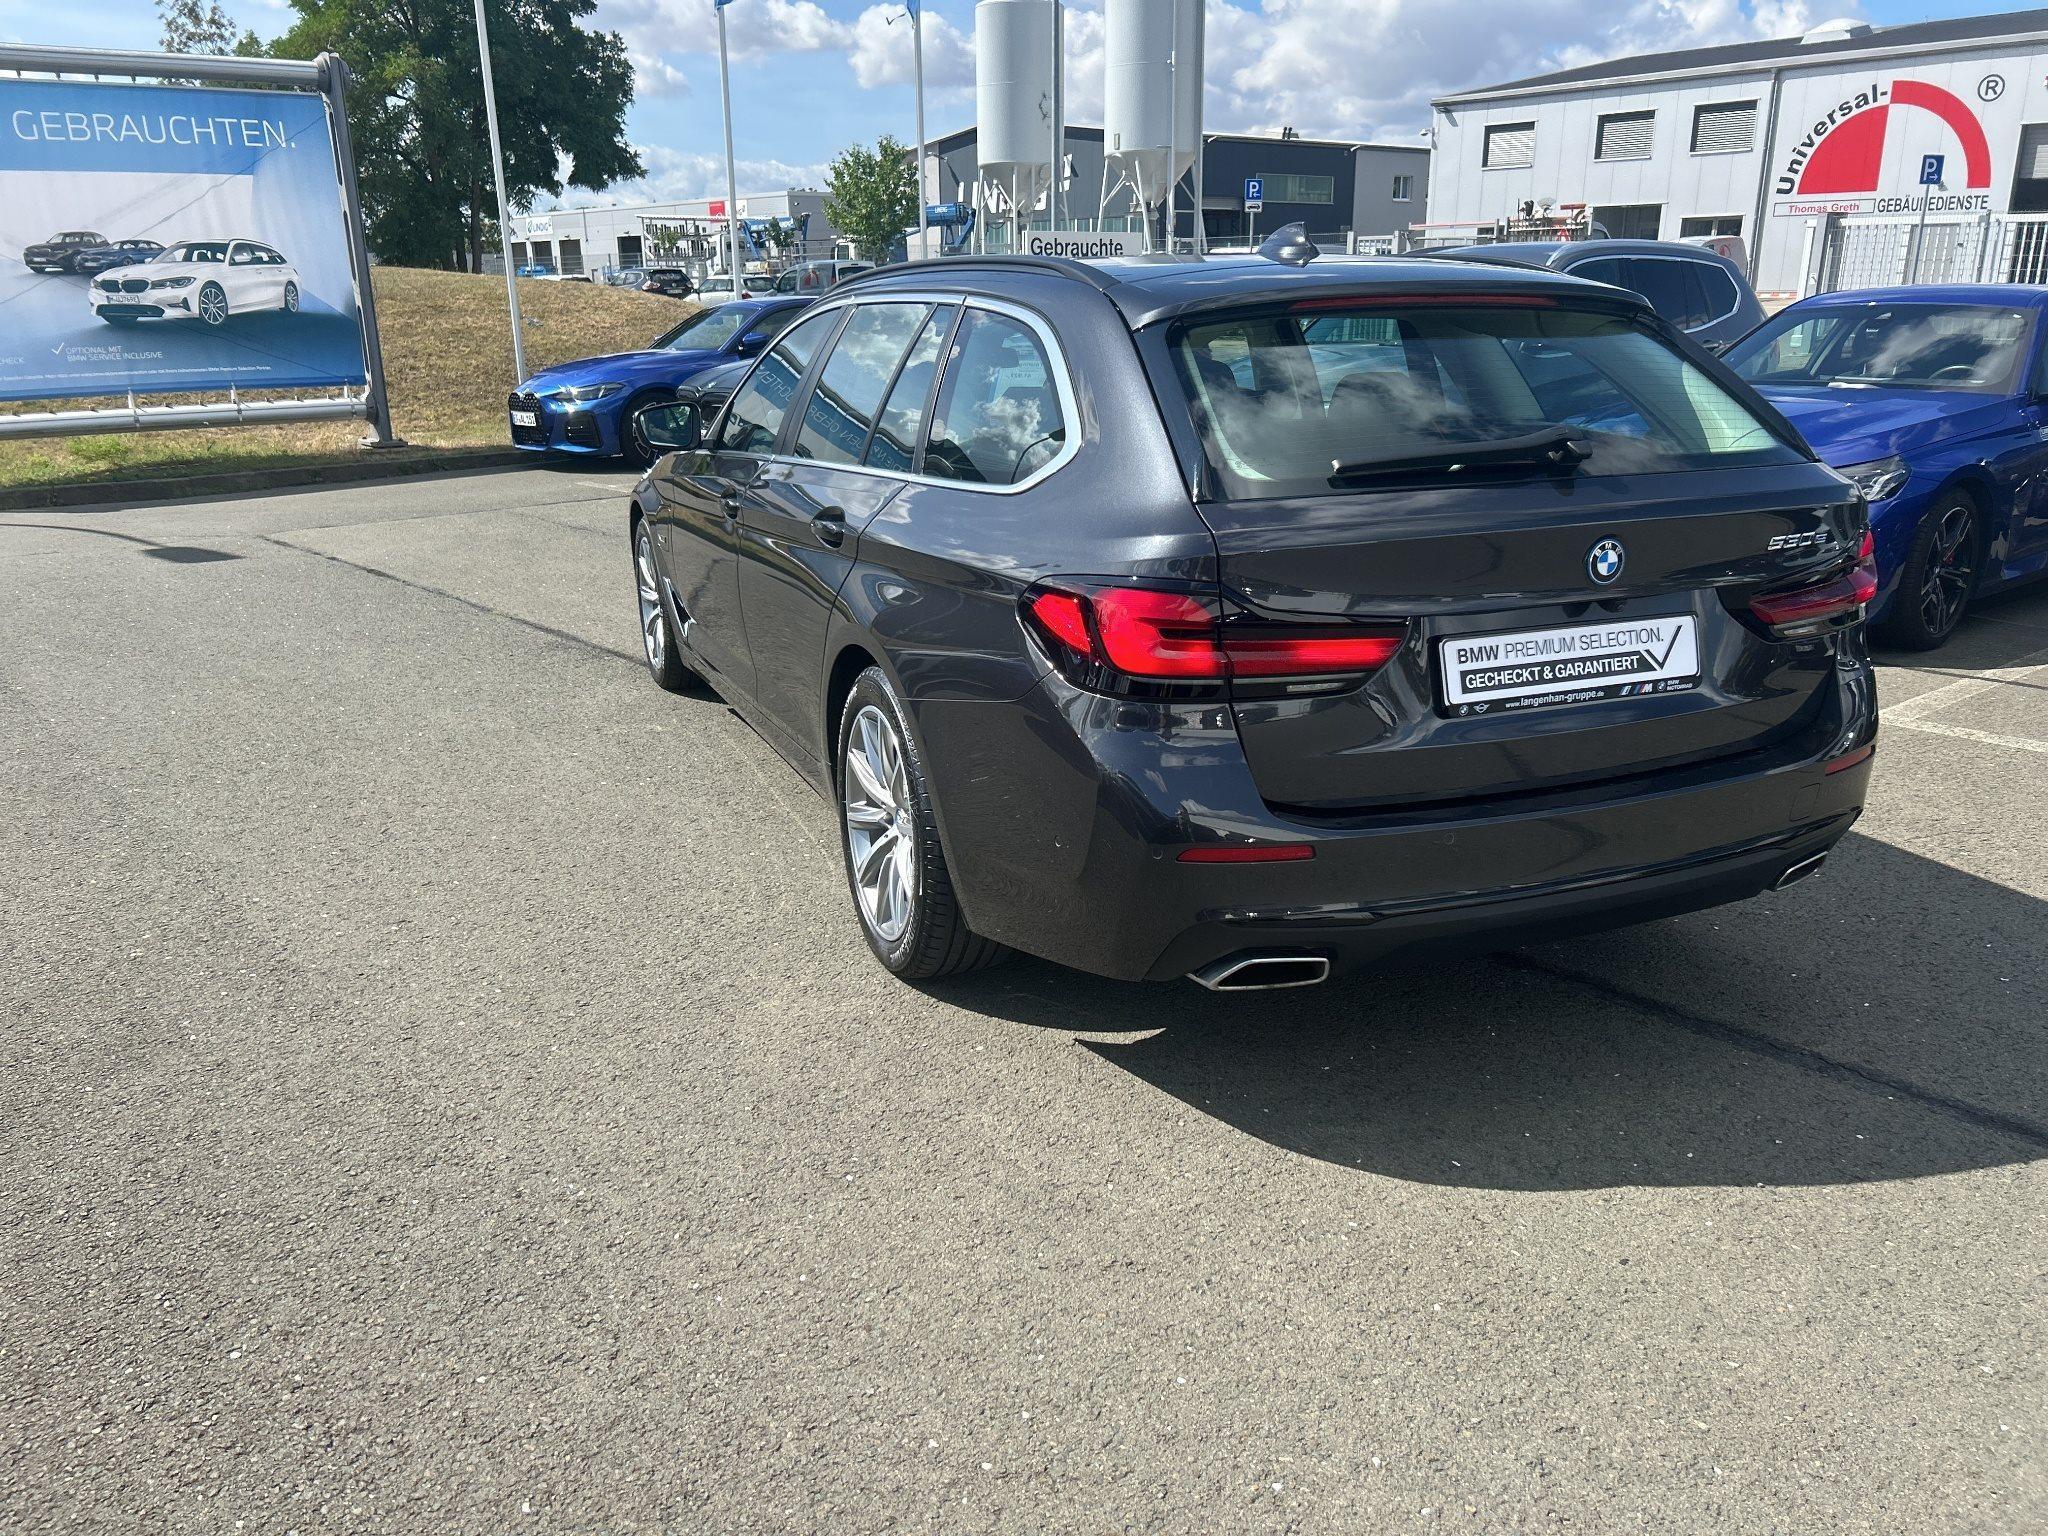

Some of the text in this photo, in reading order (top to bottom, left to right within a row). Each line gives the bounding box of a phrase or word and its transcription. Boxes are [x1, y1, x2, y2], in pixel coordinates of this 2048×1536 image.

[12, 109, 296, 149] GEBRAUCHTEN.
[1776, 84, 1888, 194] Universal-
[1923, 159, 1937, 181] P
[1249, 181, 1259, 198] P
[1788, 203, 1860, 213] Thomas Greth
[1030, 237, 1123, 257] Gebrauchte
[66, 345, 122, 354] OPTIONAL MIT
[89, 353, 122, 361] SERVICE
[123, 351, 163, 360] INCLUSIVE
[1457, 627, 1664, 664] BMW PREMIUM SELECTION.
[1466, 655, 1639, 688] GECHECKT & GARANTIERT
[1505, 689, 1605, 708] www.langenhan-gruppe.de
